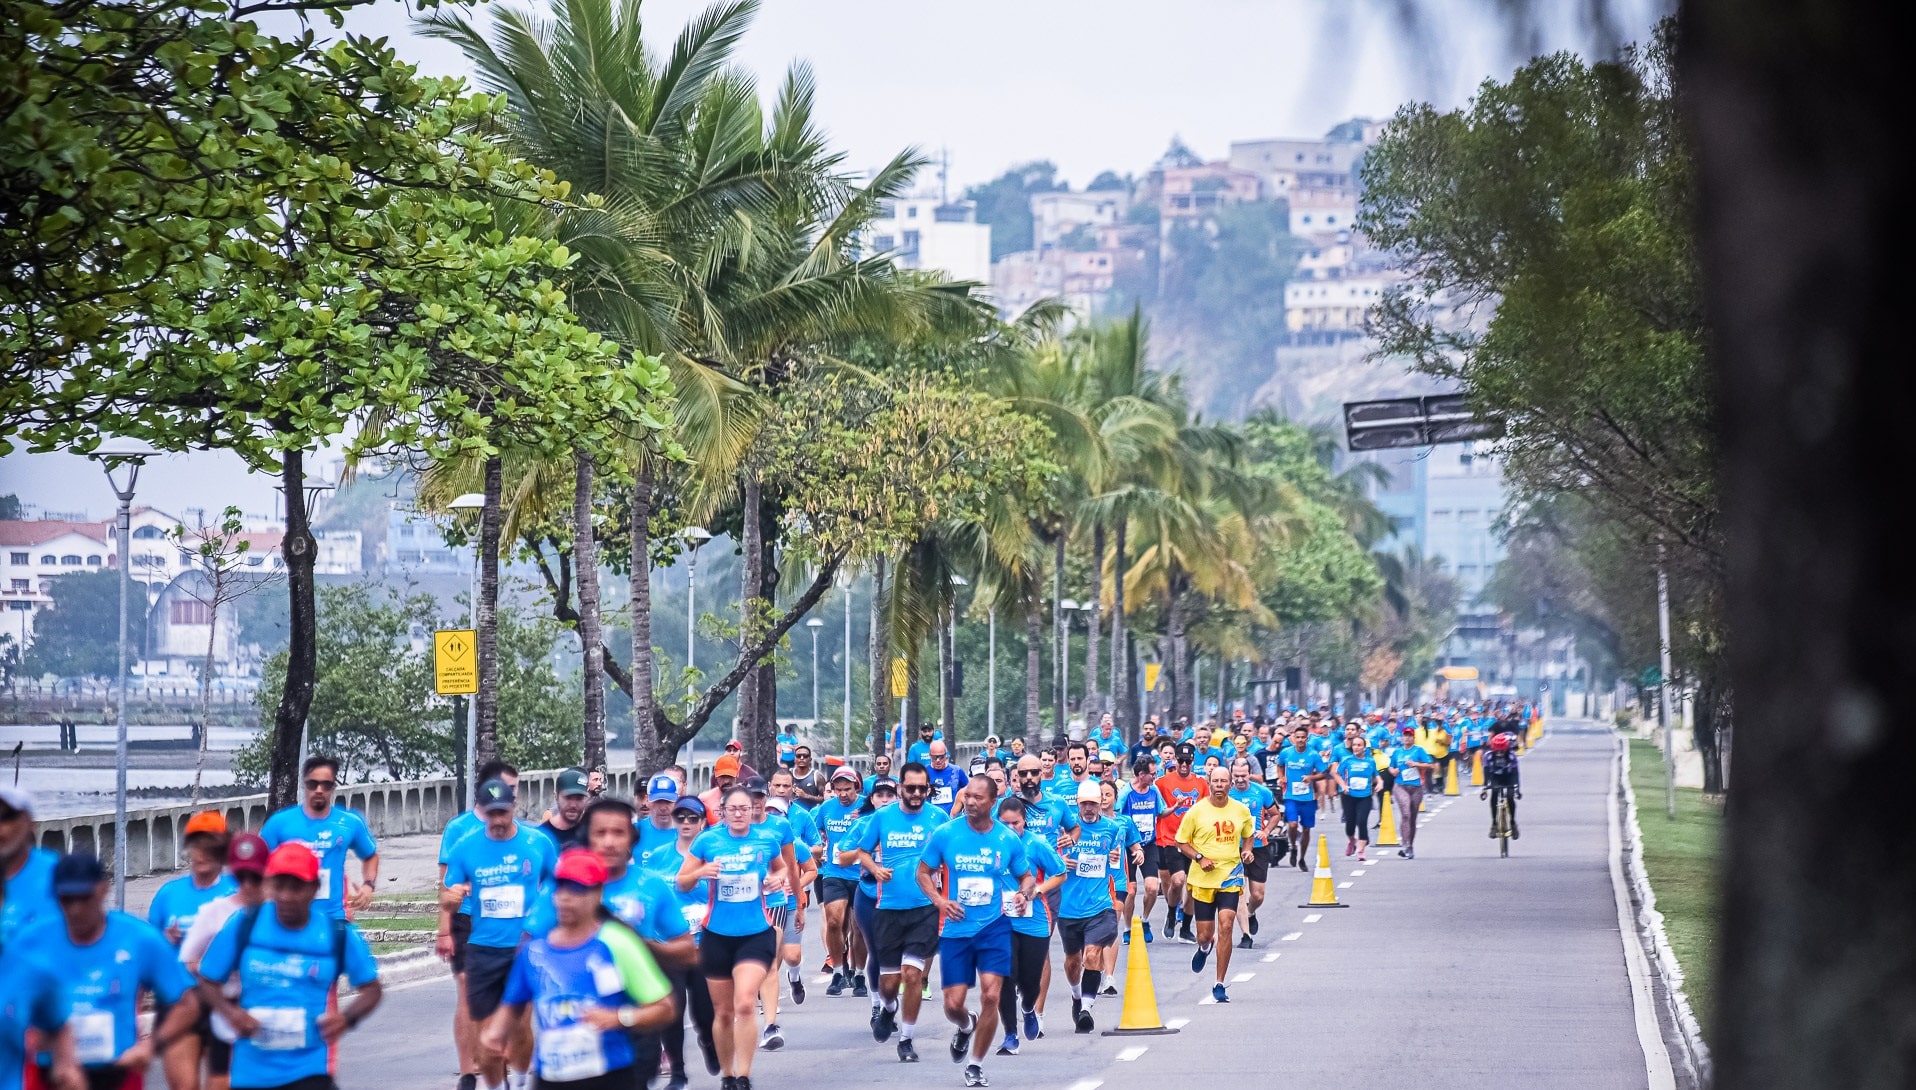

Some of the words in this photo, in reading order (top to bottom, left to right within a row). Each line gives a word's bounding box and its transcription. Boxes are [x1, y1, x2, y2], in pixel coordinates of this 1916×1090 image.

[888, 831, 925, 841] Corrida
[887, 840, 917, 849] FAESA
[1071, 846, 1096, 855] FAESA
[955, 855, 993, 865] Corrida
[475, 865, 518, 878] Corrida
[954, 863, 985, 873] FAESA
[721, 885, 752, 897] 50210
